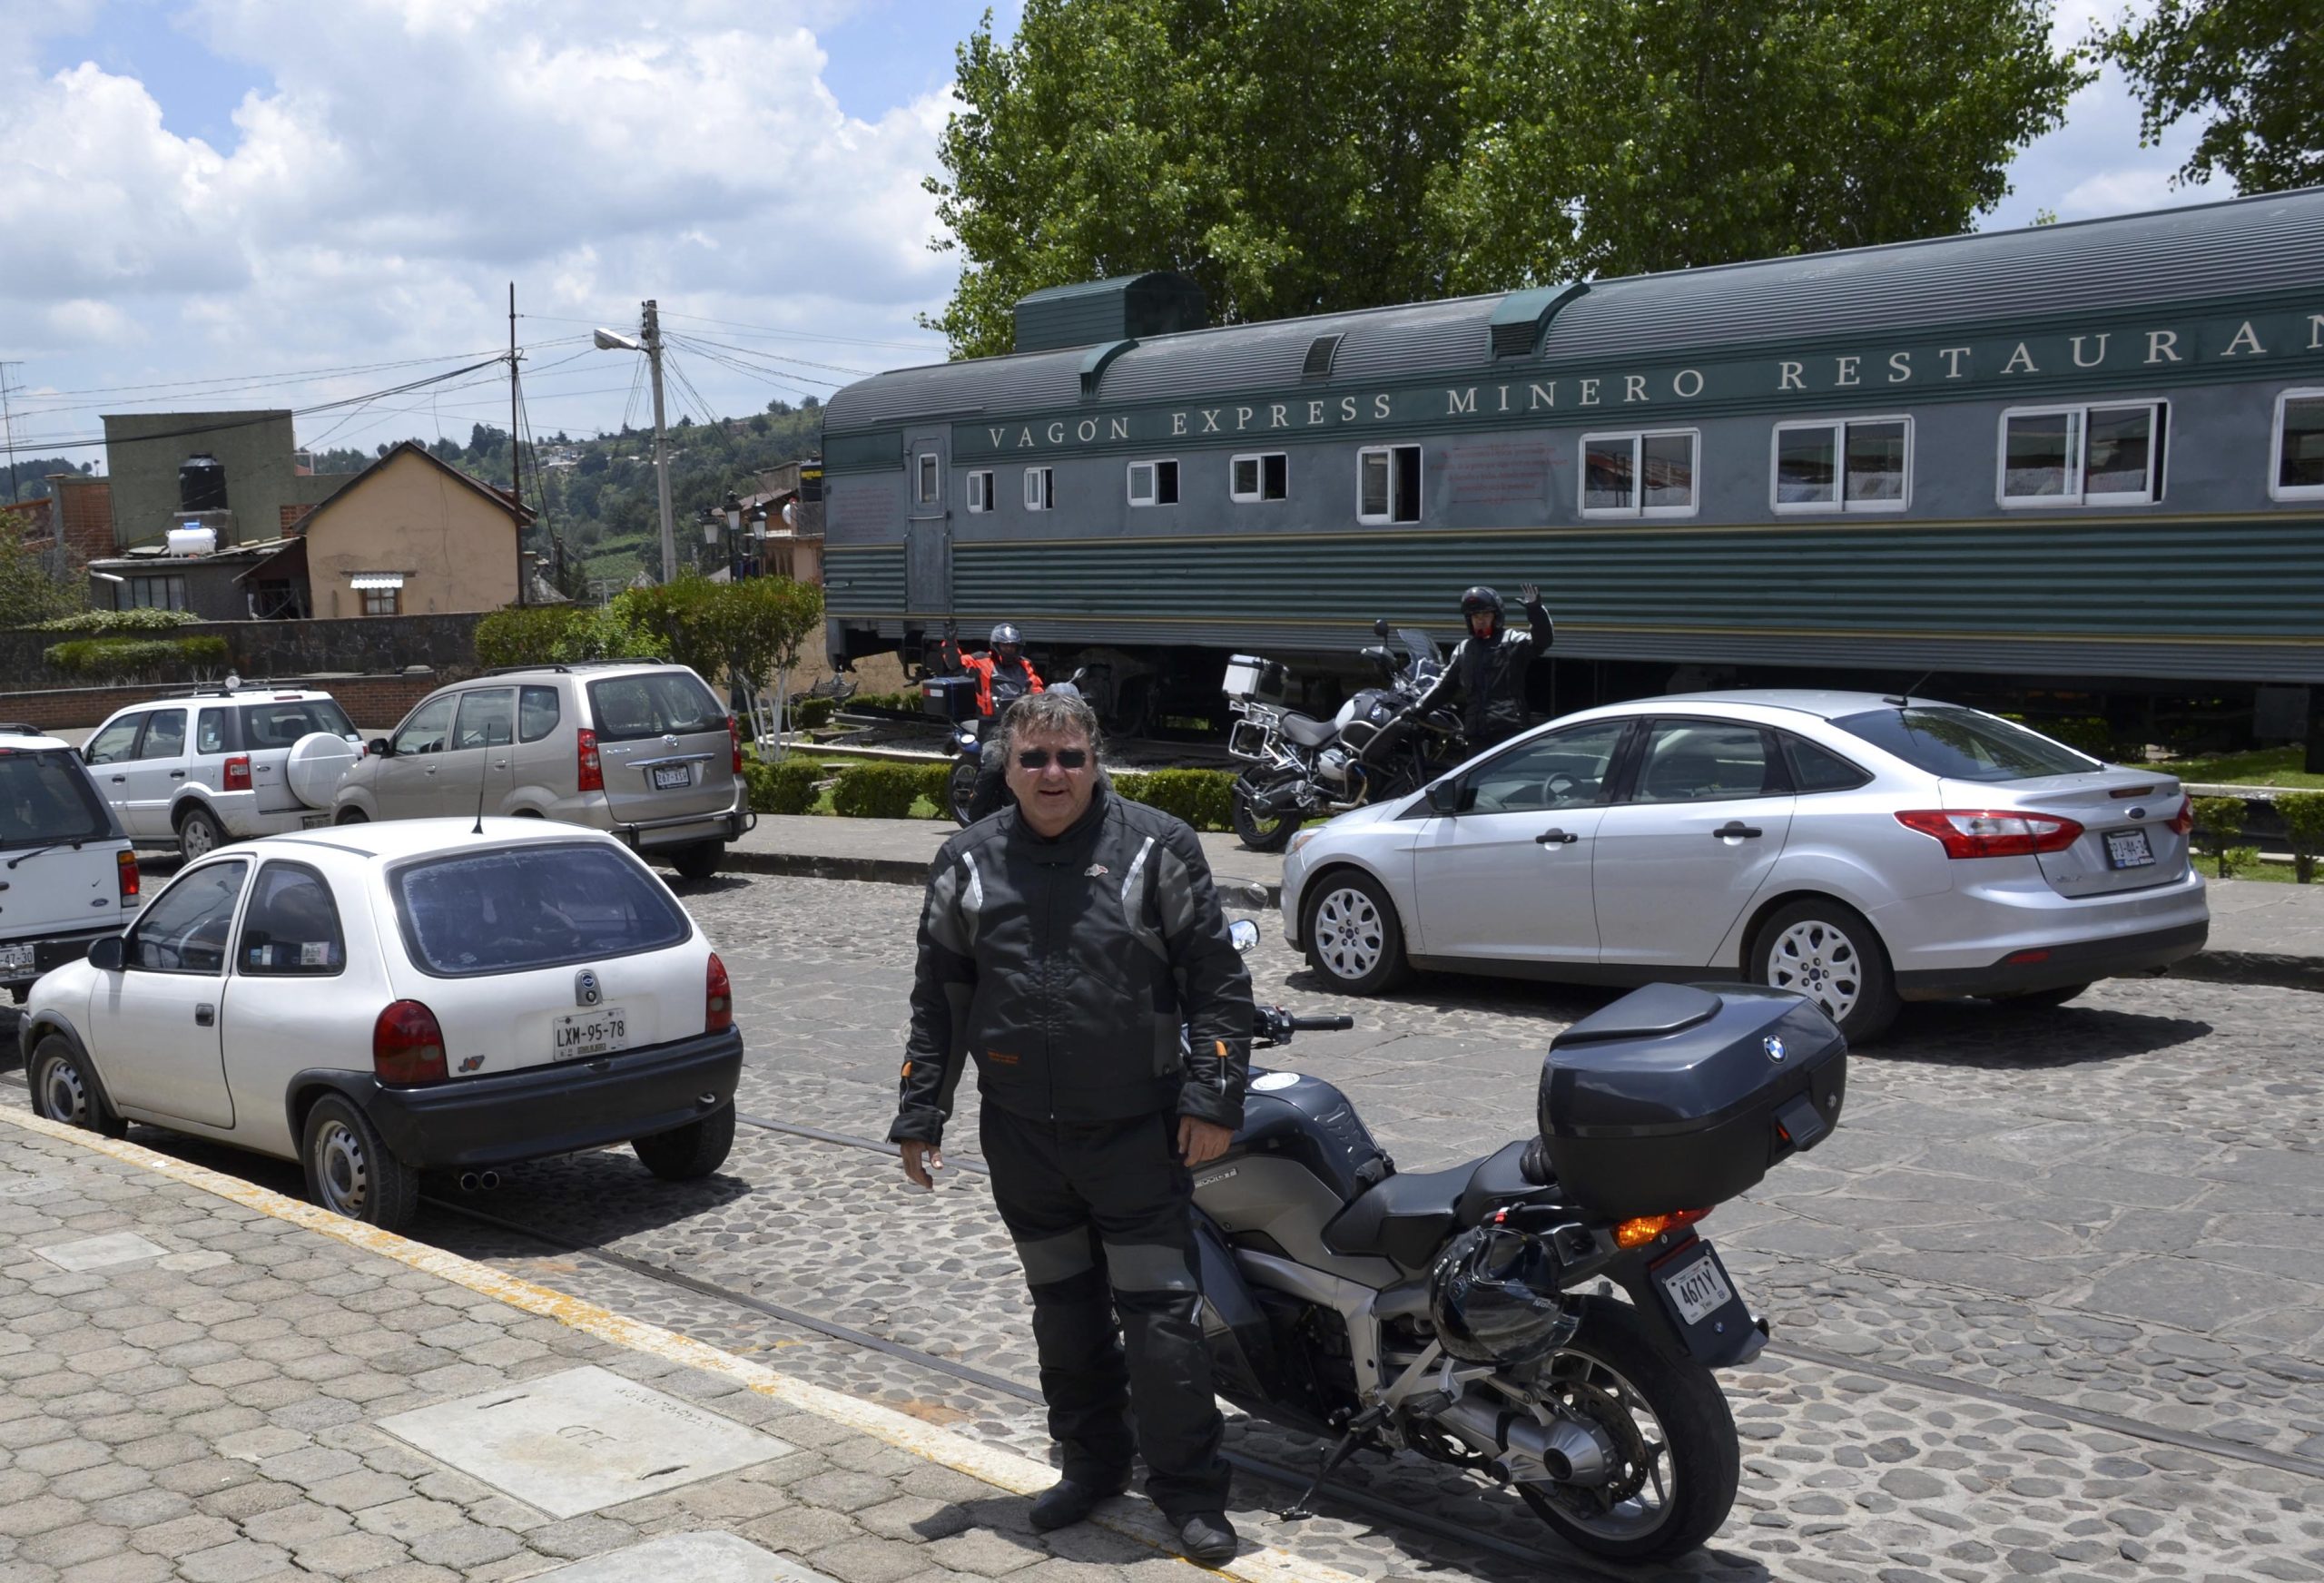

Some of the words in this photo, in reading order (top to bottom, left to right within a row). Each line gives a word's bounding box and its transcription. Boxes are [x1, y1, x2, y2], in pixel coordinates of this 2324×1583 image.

[989, 417, 1129, 448] VAGÓN
[1171, 394, 1391, 436] EXPRESS
[1446, 369, 1705, 414] MINERO
[557, 1020, 625, 1047] LXM-95-78
[1679, 1269, 1718, 1306] 4671Y
